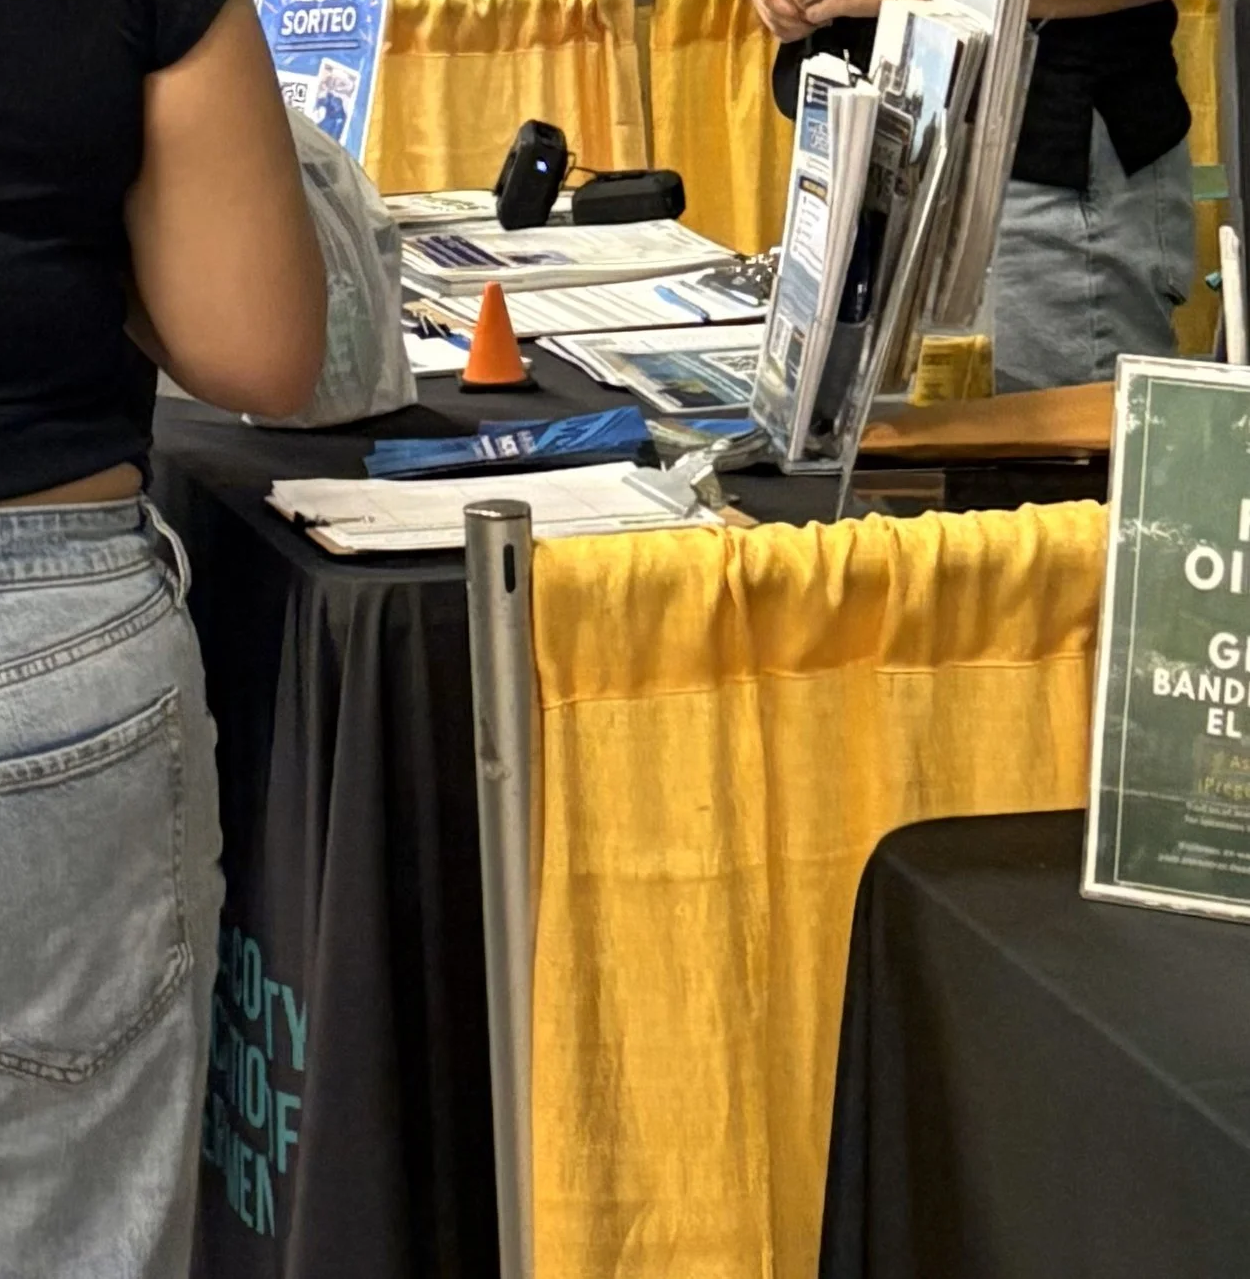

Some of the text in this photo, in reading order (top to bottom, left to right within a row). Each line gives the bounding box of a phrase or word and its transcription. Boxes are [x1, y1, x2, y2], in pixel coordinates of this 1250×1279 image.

[281, 6, 357, 36] SORTEO
[1153, 667, 1250, 708] BAND
[1207, 707, 1242, 739] EL
